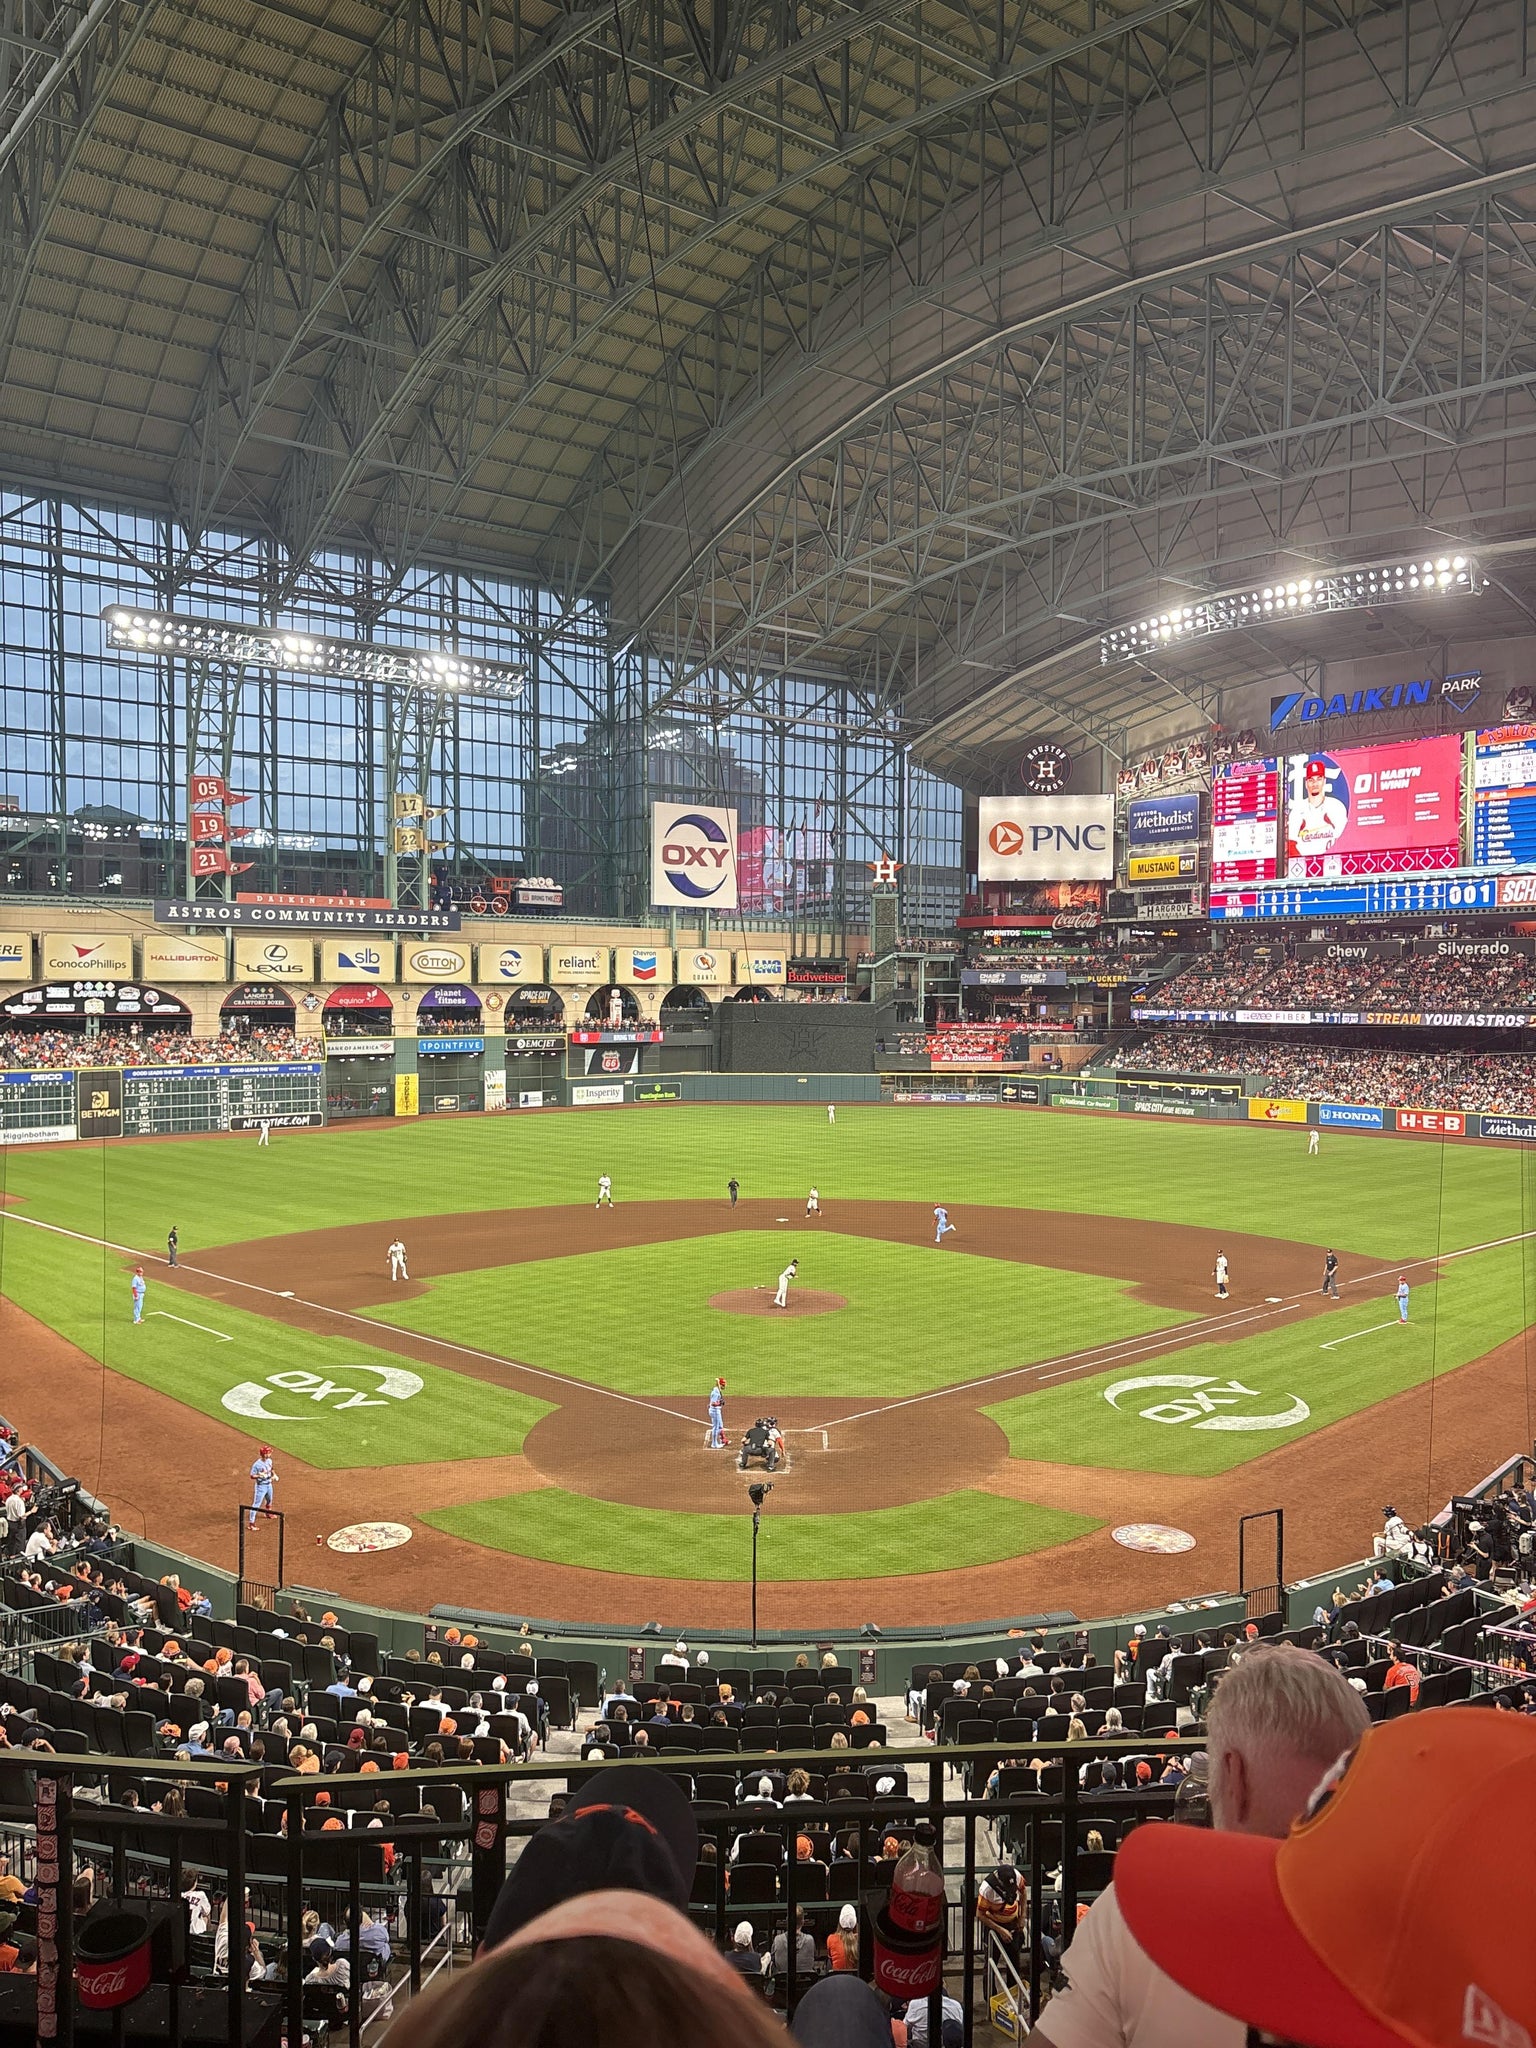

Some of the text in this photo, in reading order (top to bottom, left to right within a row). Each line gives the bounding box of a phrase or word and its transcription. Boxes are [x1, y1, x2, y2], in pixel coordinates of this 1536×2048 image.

[1300, 676, 1482, 721] DAIKIN PARK
[1027, 744, 1067, 761] HOUSTON
[1188, 743, 1204, 759] 33
[1164, 752, 1180, 767] 25
[1037, 760, 1056, 778] H
[1140, 760, 1156, 775] 40
[1117, 769, 1133, 784] 32
[198, 781, 218, 796] 05
[1028, 779, 1065, 793] ASTROS
[1354, 773, 1372, 794] 0
[1380, 779, 1410, 791] WINN
[401, 800, 417, 812] 17
[199, 819, 218, 832] 19
[1133, 810, 1193, 829] Methodist
[401, 834, 417, 846] 22
[1029, 824, 1106, 851] PNC
[199, 853, 217, 867] 21
[662, 844, 730, 868] OXY
[1137, 861, 1175, 874] MUSTANG
[1180, 859, 1195, 871] CAT
[873, 861, 898, 883] H
[256, 895, 367, 906] DAIKIN PARK
[1227, 886, 1439, 905] STL 2 0 2 0 4 4 0 2 3
[1449, 884, 1490, 905] 0 0 1
[1147, 904, 1193, 918] HARGROVE
[1225, 907, 1243, 917] HOU
[1271, 906, 1277, 914] 0
[1283, 905, 1289, 914] 0
[1295, 904, 1301, 913] 0
[1390, 900, 1397, 909] 3
[1404, 899, 1411, 908] 2
[1418, 899, 1425, 908] 2
[1432, 898, 1439, 907] 3
[168, 906, 450, 926] ASTROS COMMUNITY LEADERS
[983, 929, 1021, 937] HORNITOS
[632, 949, 657, 957] Chevron
[1327, 945, 1367, 959] Chevy
[1438, 940, 1510, 955] Silverado
[355, 948, 380, 964] slb
[417, 954, 457, 971] COTTON
[559, 956, 597, 969] reliant
[49, 958, 127, 970] ConocoPhillips
[245, 963, 304, 974] LEXUS
[754, 959, 782, 974] LNG
[787, 972, 846, 982] Budweiser
[1087, 975, 1127, 983] PLUCKERS
[434, 988, 462, 999] planet
[520, 990, 552, 1000] SPACE CITY
[338, 997, 366, 1006] equinor
[437, 996, 467, 1005] fitness
[1275, 1013, 1306, 1022] FIBER
[1366, 1012, 1526, 1027] STREAM YOUR ASTROS
[422, 1041, 480, 1051] 1POINTFIVE
[525, 1039, 556, 1049] EMCJET
[605, 1058, 618, 1067] 66
[951, 1053, 994, 1062] Budweiser
[30, 1073, 63, 1081] GEICO
[371, 1086, 388, 1094] 366
[585, 1087, 621, 1098] Insperity
[1190, 1088, 1205, 1096] 370
[1065, 1098, 1086, 1106] National
[1134, 1102, 1151, 1112] SPACE
[1151, 1103, 1163, 1114] CITY
[81, 1108, 120, 1119] BETMGM
[1331, 1110, 1381, 1122] HONDA
[3, 1131, 60, 1141] Higginbotham
[265, 1370, 391, 1410] OXY
[1138, 1380, 1262, 1424] OXY
[880, 1957, 937, 1985] Coca-Cola
